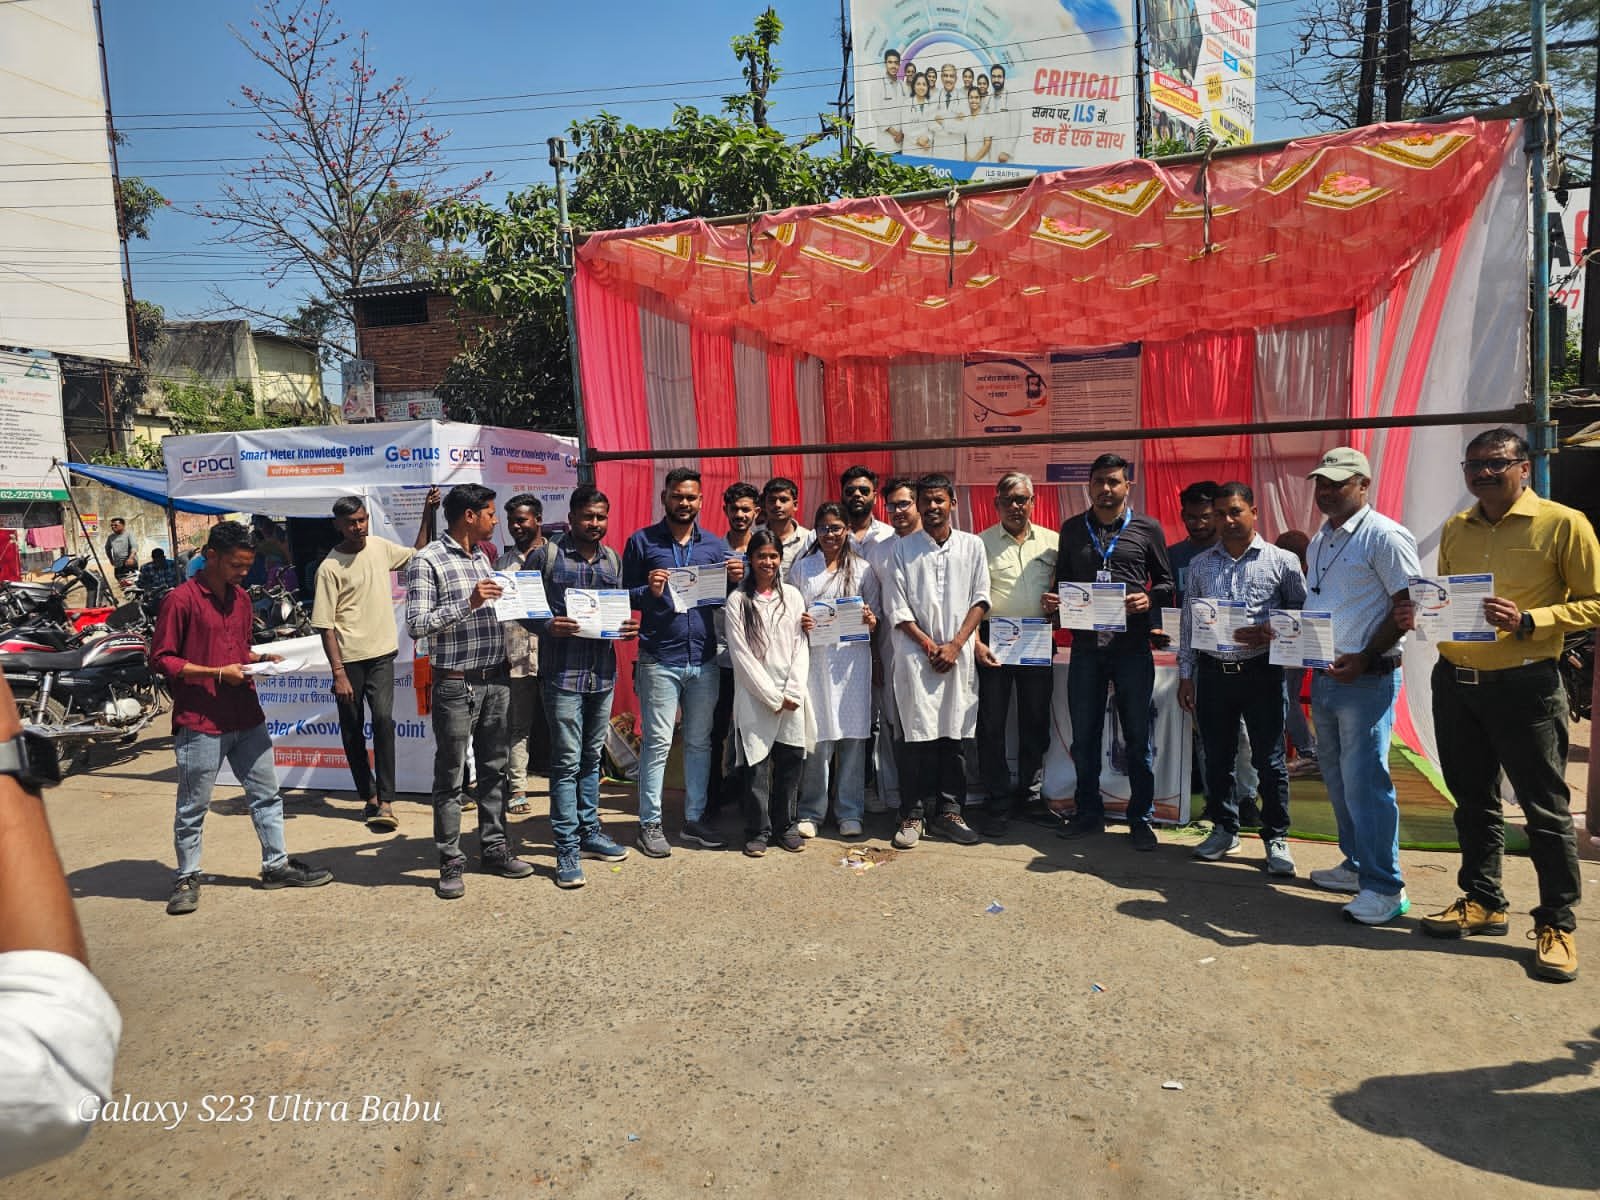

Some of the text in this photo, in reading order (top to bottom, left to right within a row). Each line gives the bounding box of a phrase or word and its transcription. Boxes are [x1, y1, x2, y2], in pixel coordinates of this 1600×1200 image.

[1033, 68, 1120, 101] CRITICAL
[1032, 106, 1056, 119] समय
[1073, 103, 1096, 122] ILS
[1032, 127, 1056, 144] हम
[1071, 129, 1094, 147] एक
[1095, 131, 1126, 150] साथ
[240, 444, 374, 461] Smart Meter Knowledge Point
[384, 445, 440, 462] Genus
[267, 719, 292, 736] eter
